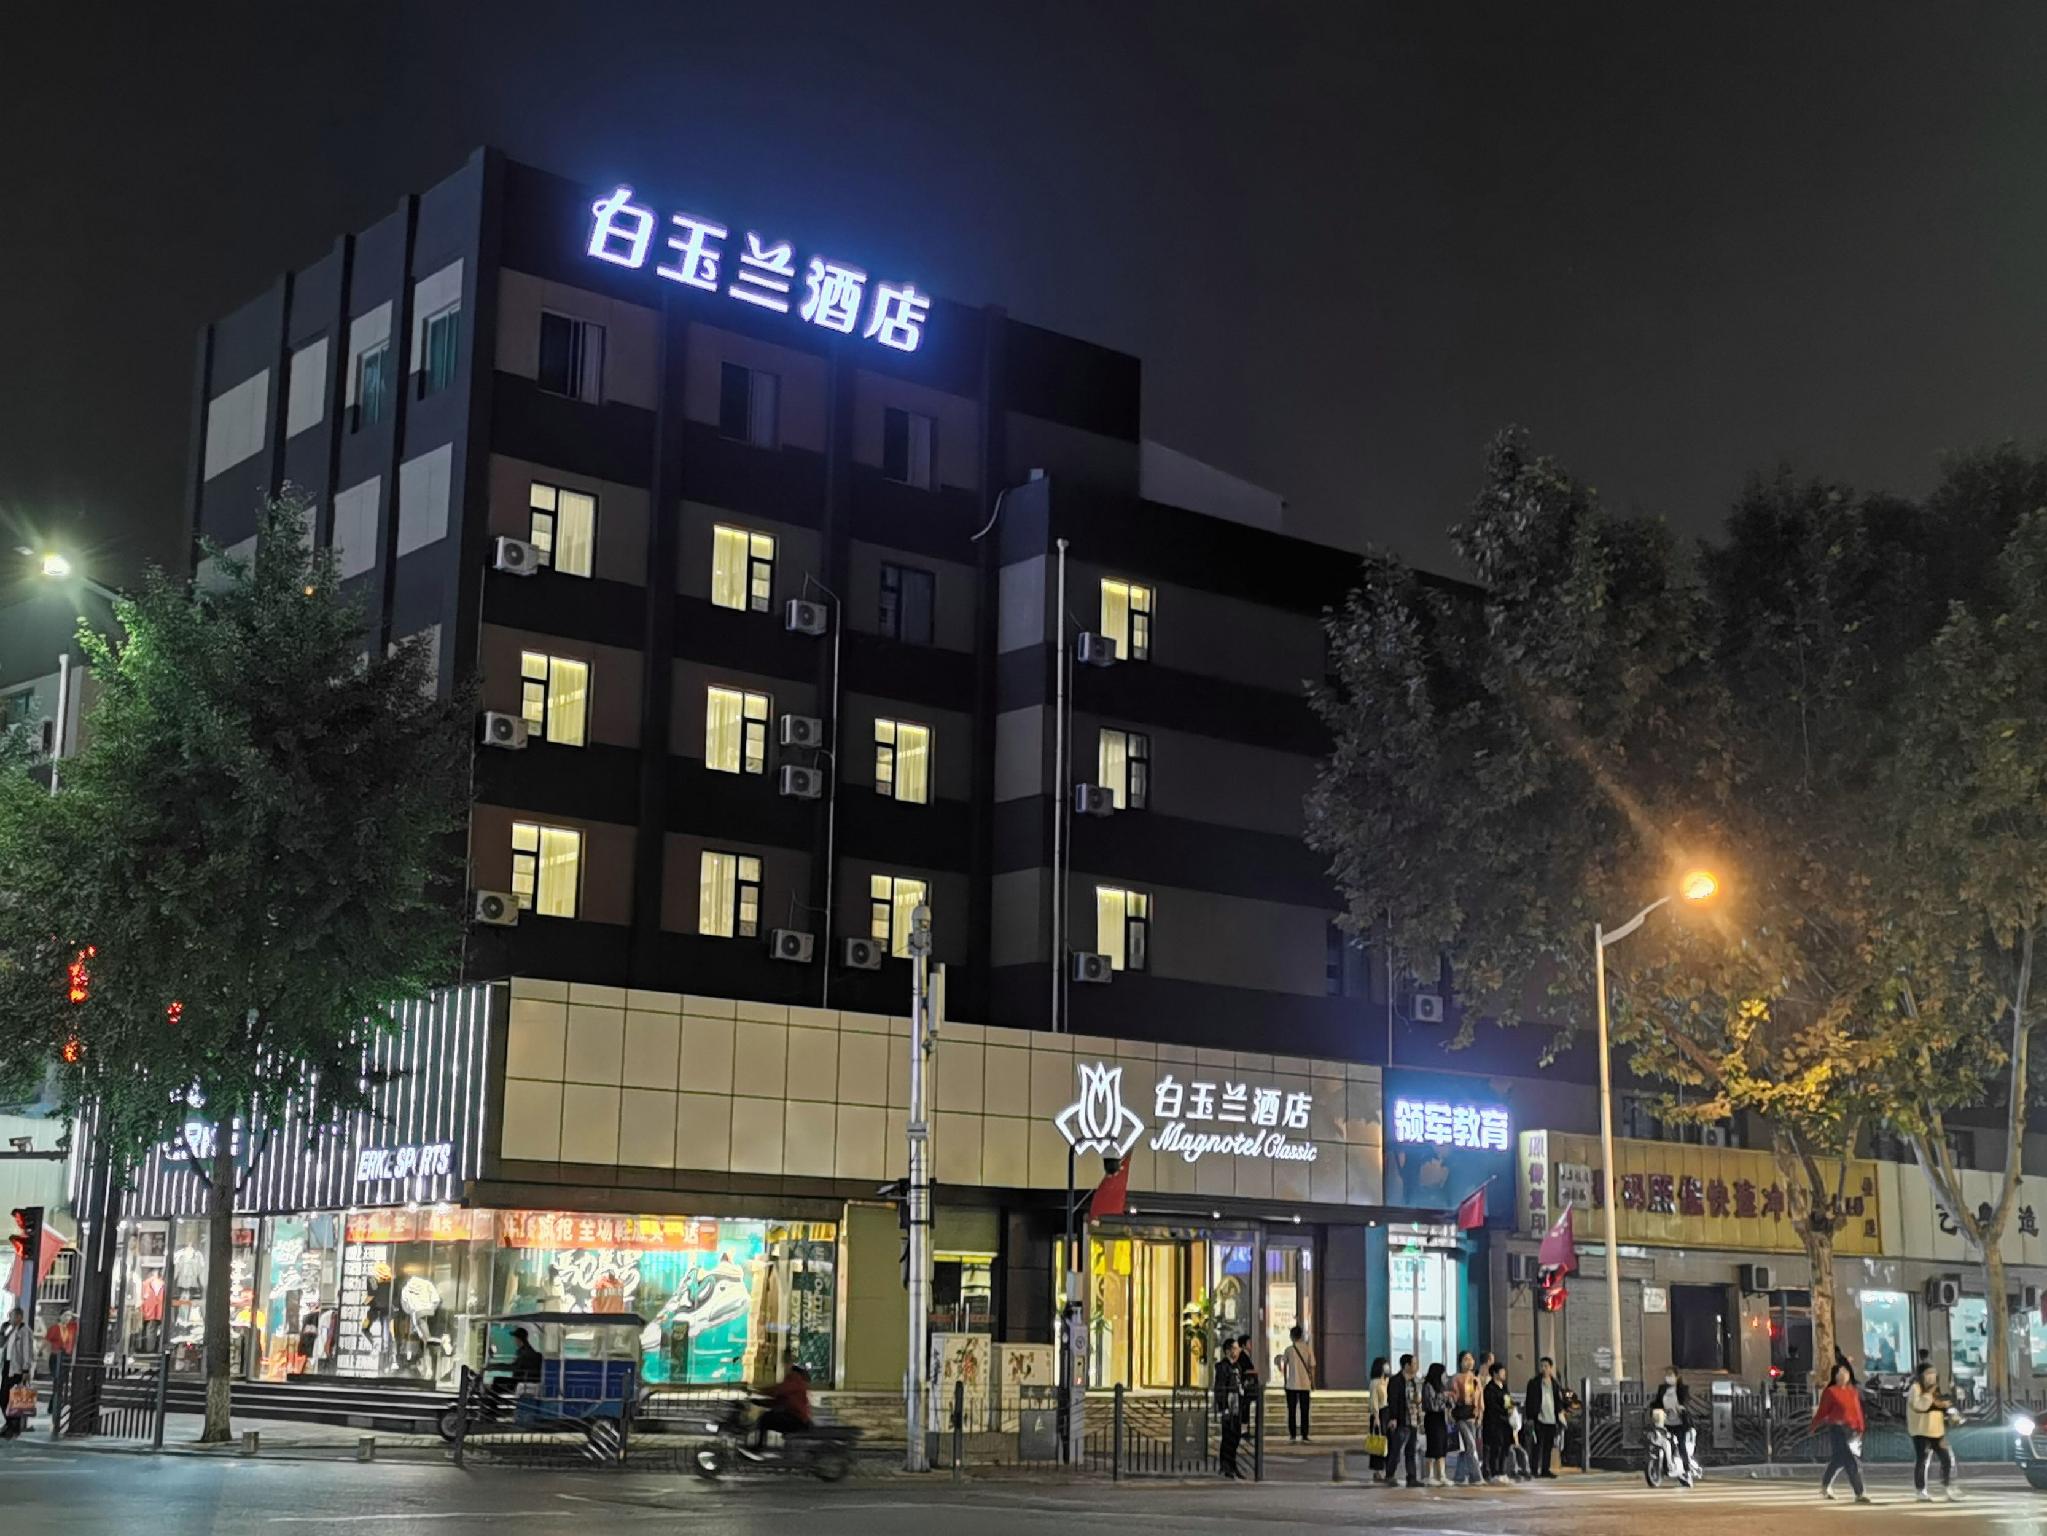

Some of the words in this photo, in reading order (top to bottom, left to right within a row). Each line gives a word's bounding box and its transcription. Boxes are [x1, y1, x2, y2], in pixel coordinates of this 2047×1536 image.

[586, 187, 931, 354] 白玉兰酒店
[1154, 1074, 1313, 1130] 白玉兰酒店
[1394, 1099, 1509, 1151] 领军教育
[1150, 1120, 1267, 1163] Magnotel
[1264, 1132, 1319, 1162] Classic
